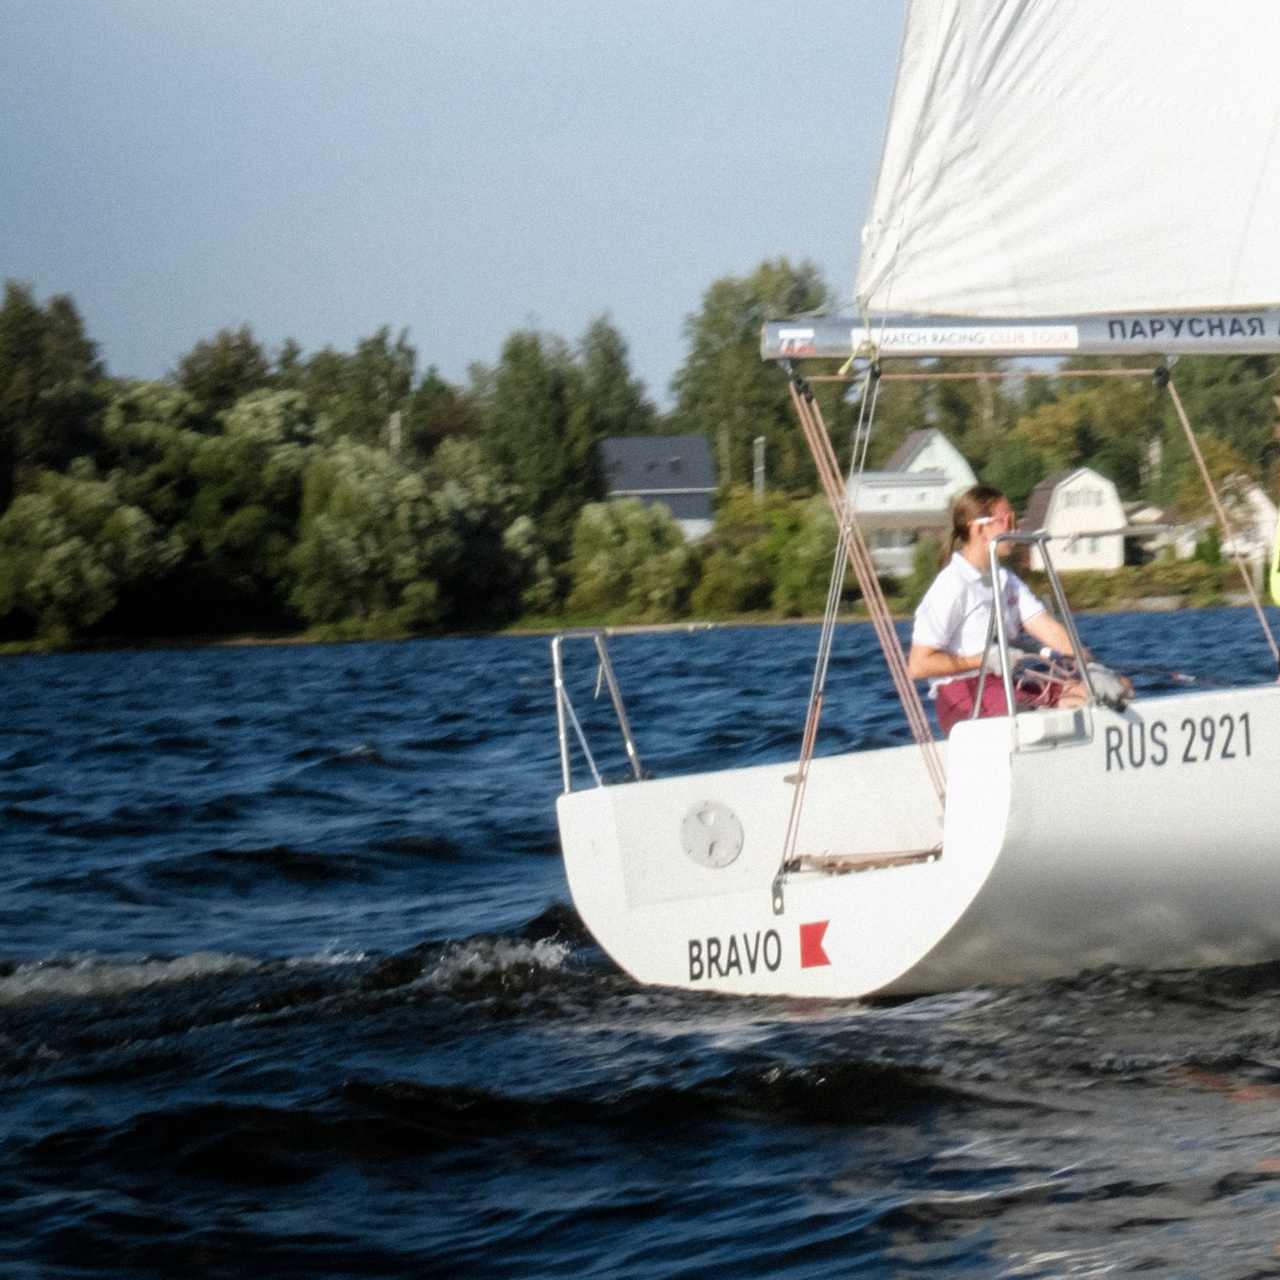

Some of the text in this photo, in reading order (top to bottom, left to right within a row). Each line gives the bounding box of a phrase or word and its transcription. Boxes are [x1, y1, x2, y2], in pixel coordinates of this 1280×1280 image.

[931, 332, 985, 344] RACING
[989, 331, 1025, 343] CLUB
[1031, 330, 1070, 343] TOUR
[1108, 317, 1265, 339] ПАРУСНАЯ
[1106, 712, 1251, 772] RUS 2921
[688, 928, 782, 981] BRAVO
